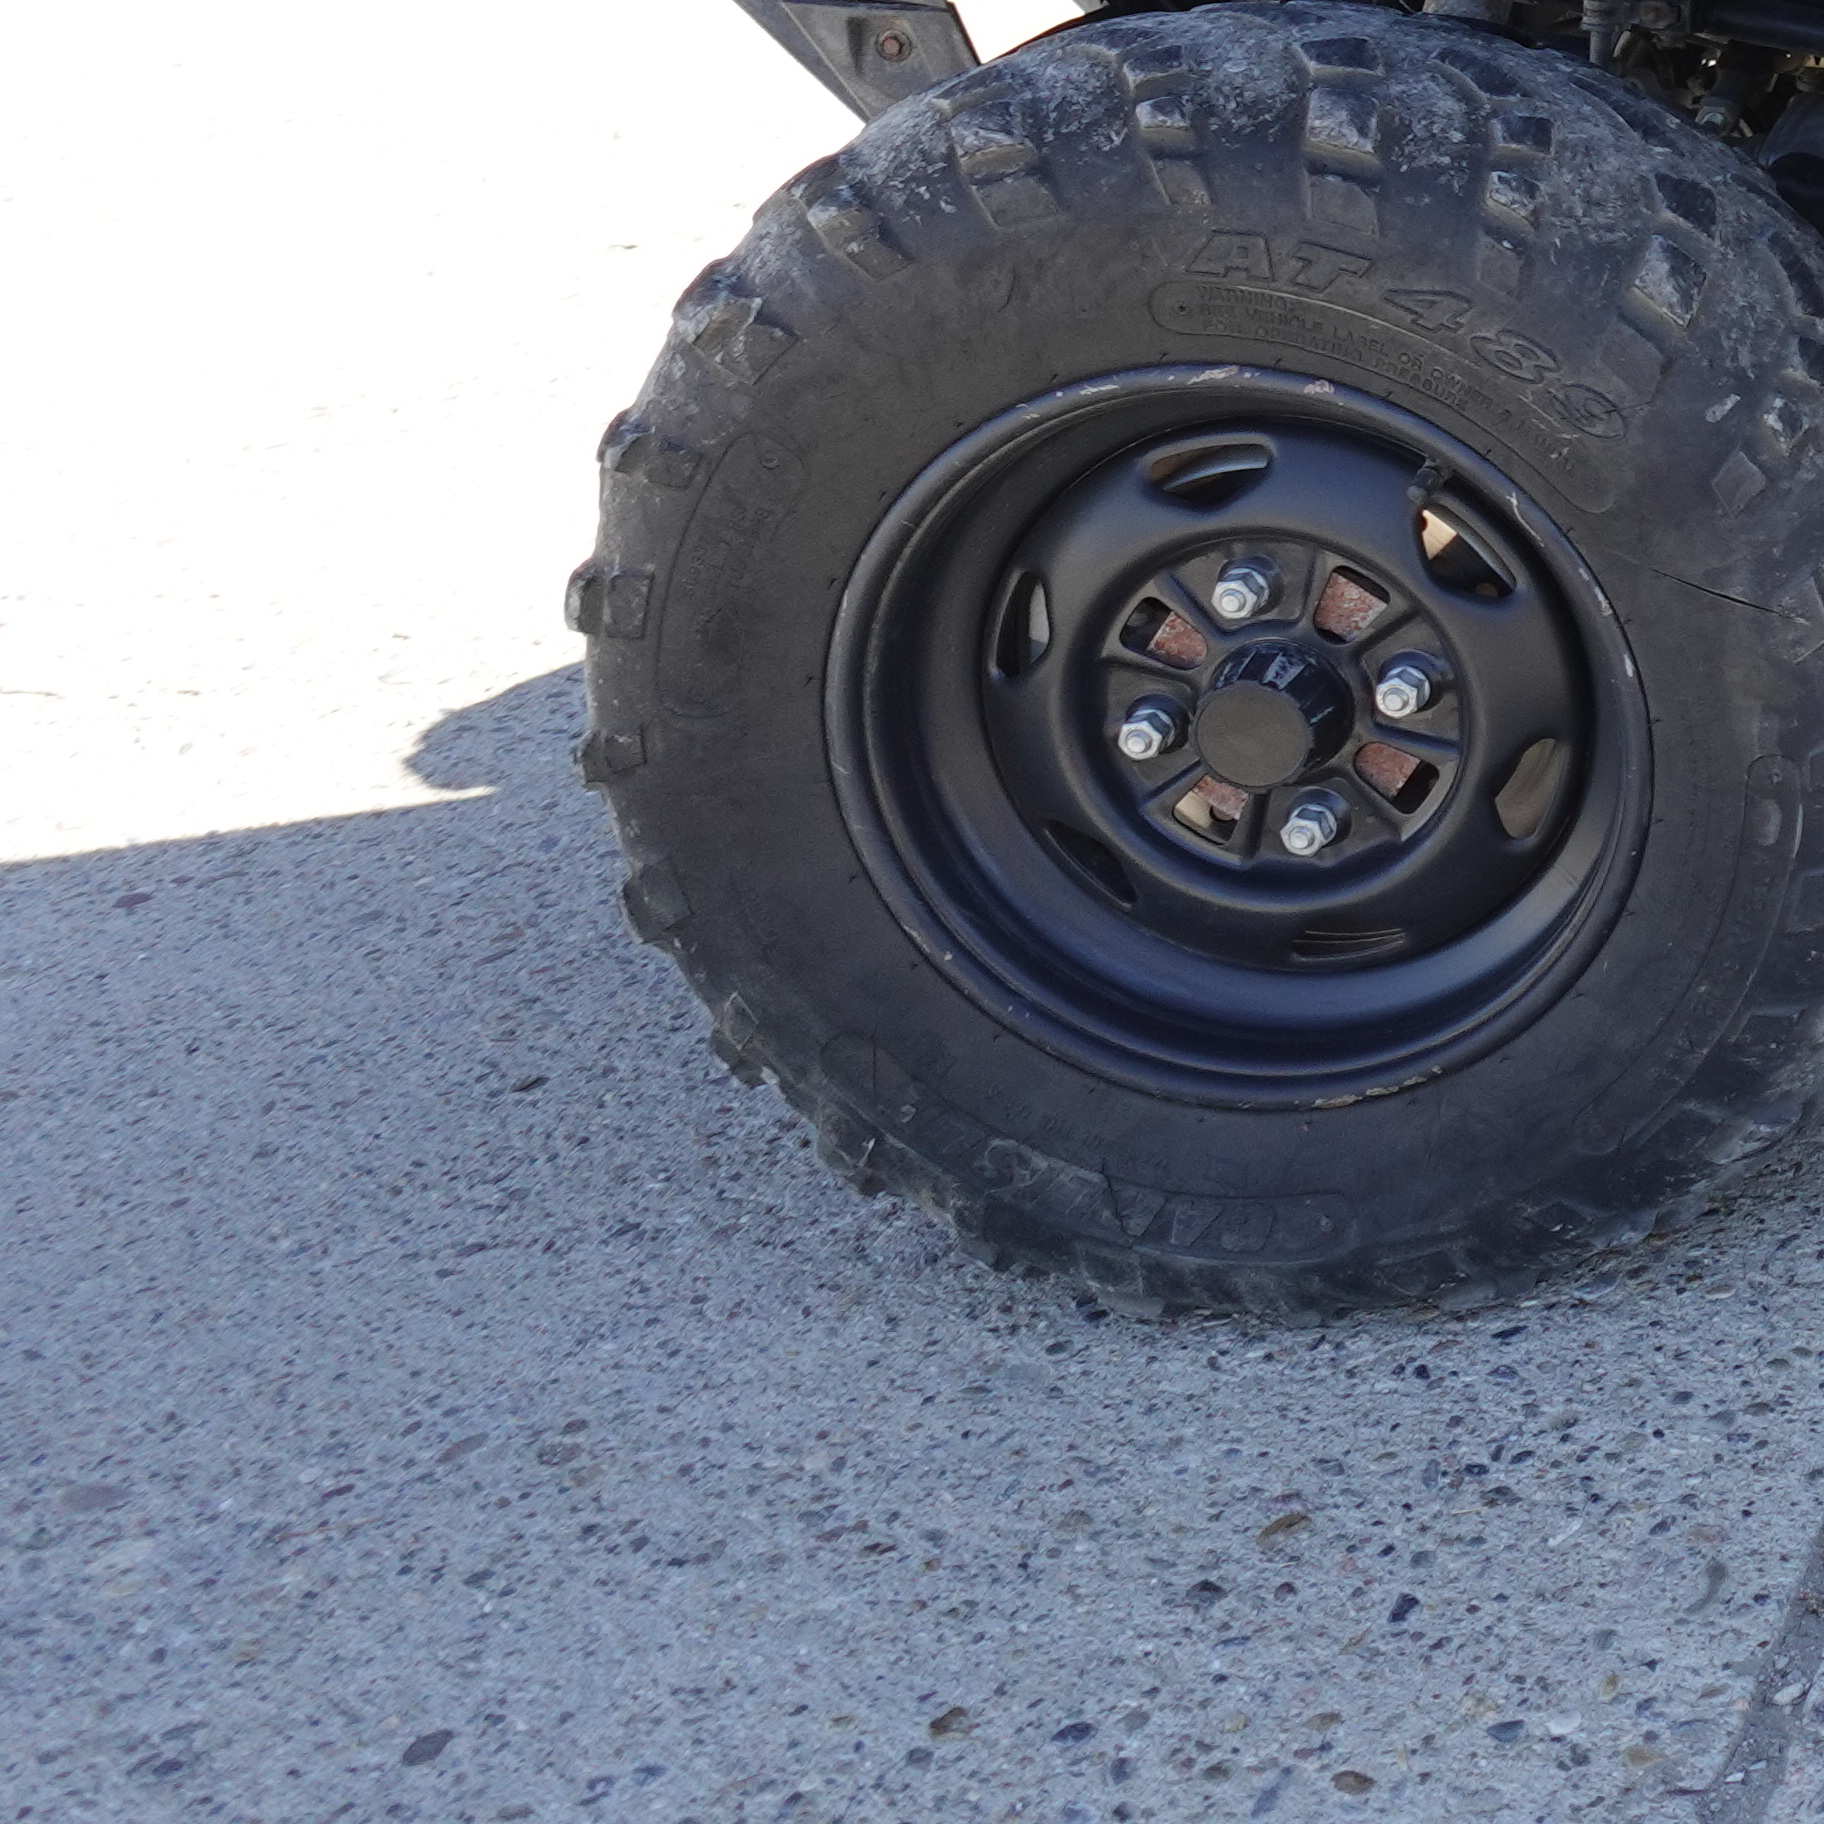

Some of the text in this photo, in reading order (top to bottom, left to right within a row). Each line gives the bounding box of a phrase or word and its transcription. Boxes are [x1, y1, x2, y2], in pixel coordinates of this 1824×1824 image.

[1185, 228, 1628, 441] AT 489
[1333, 325, 1391, 357] LABEL
